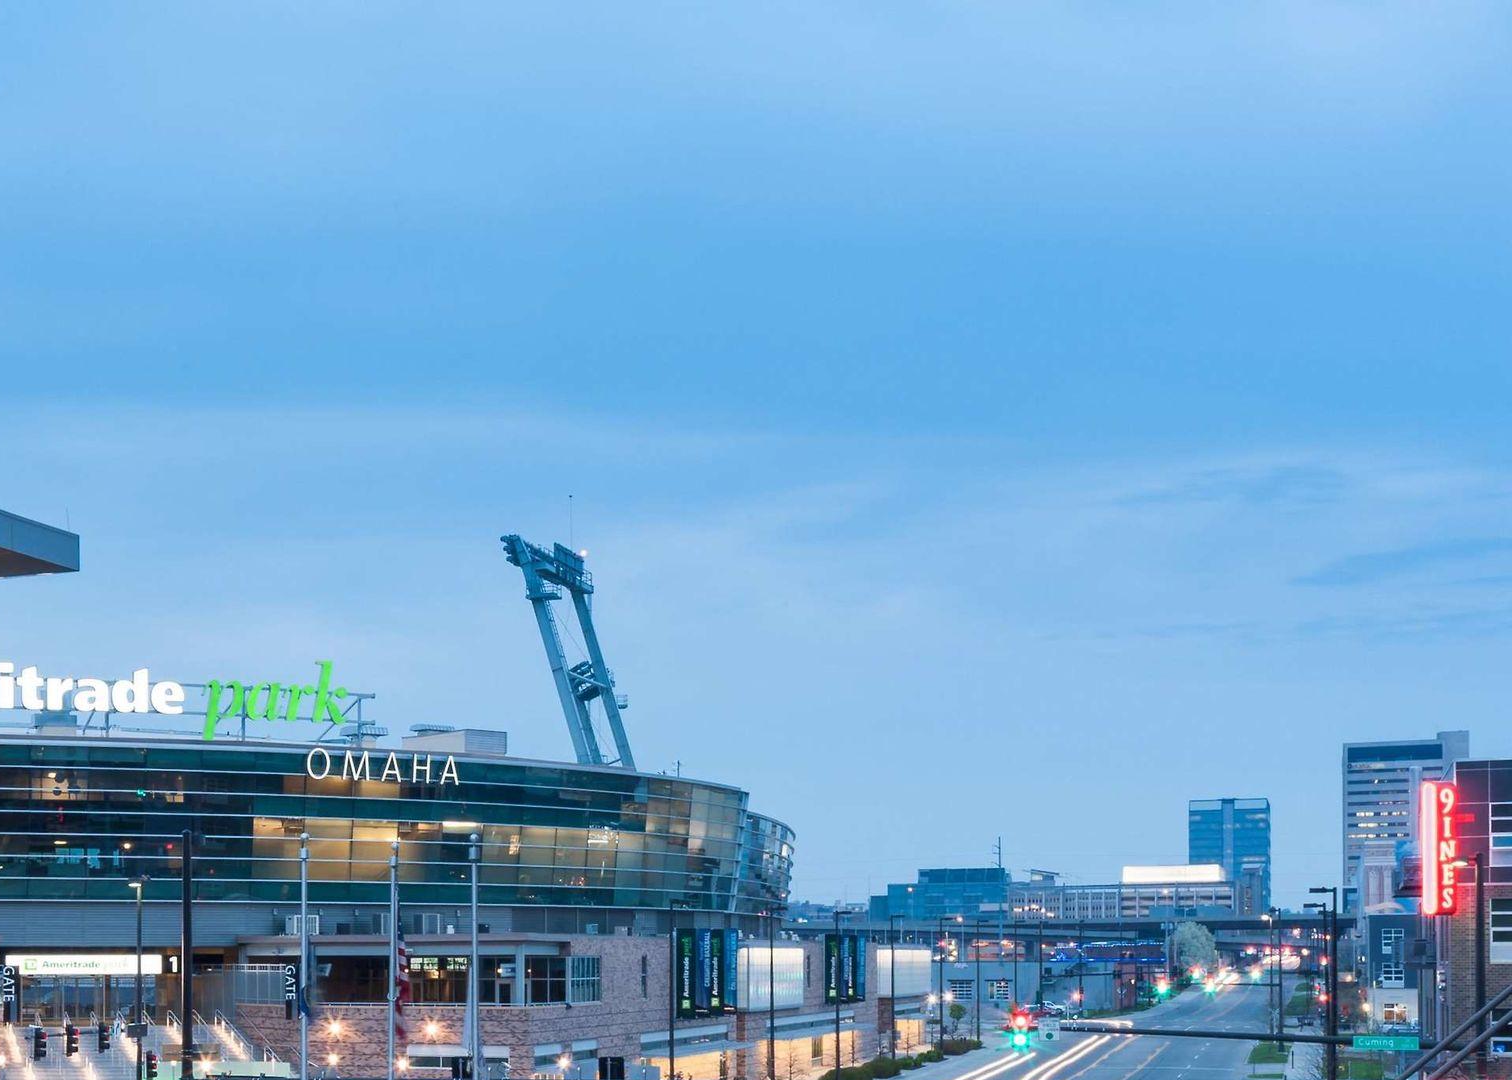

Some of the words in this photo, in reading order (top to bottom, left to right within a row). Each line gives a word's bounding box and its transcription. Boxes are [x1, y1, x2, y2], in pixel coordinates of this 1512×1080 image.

[203, 660, 350, 741] park
[306, 747, 460, 786] OMAHA
[42, 960, 101, 969] Ameritrade
[168, 956, 178, 973] 1
[2, 966, 15, 1002] GATE
[285, 965, 296, 1000] GATE
[1358, 1037, 1395, 1048] Cuming
